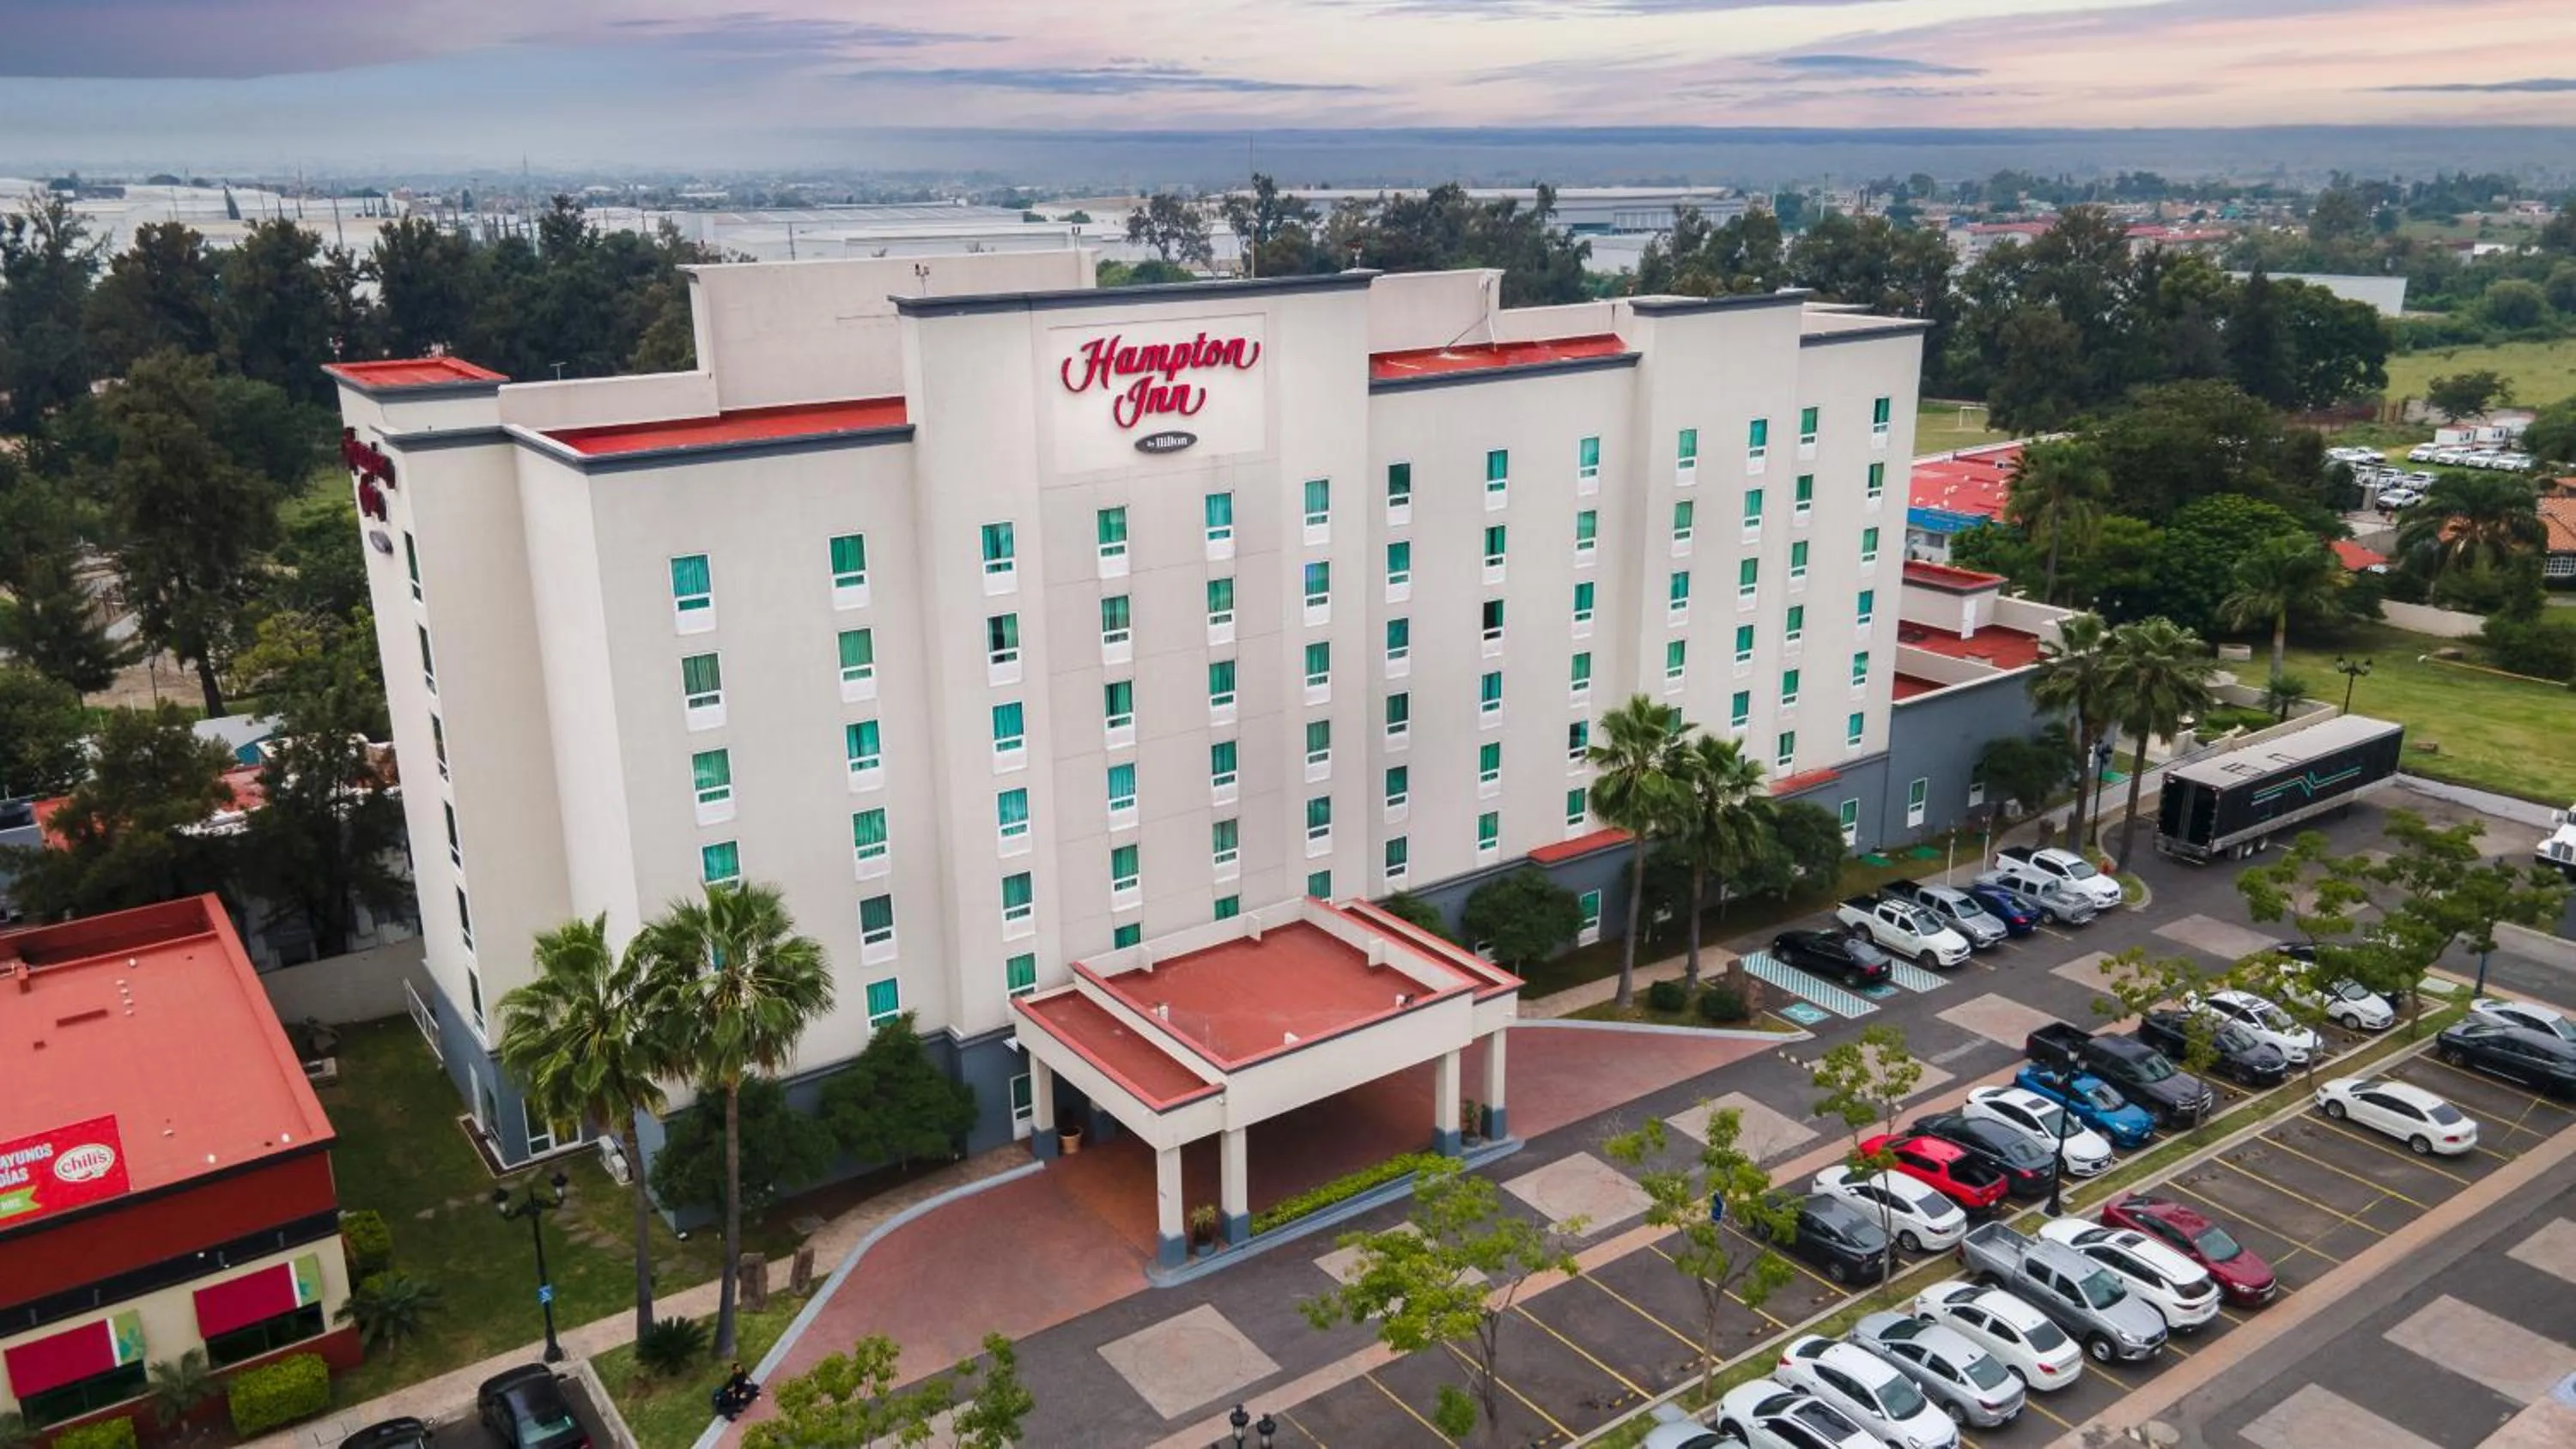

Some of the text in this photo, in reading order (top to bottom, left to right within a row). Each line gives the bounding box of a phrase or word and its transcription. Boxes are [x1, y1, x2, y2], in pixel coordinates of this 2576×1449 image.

[1060, 332, 1261, 392] Hampton
[1114, 376, 1206, 428] Inn
[1156, 435, 1188, 448] Hilton
